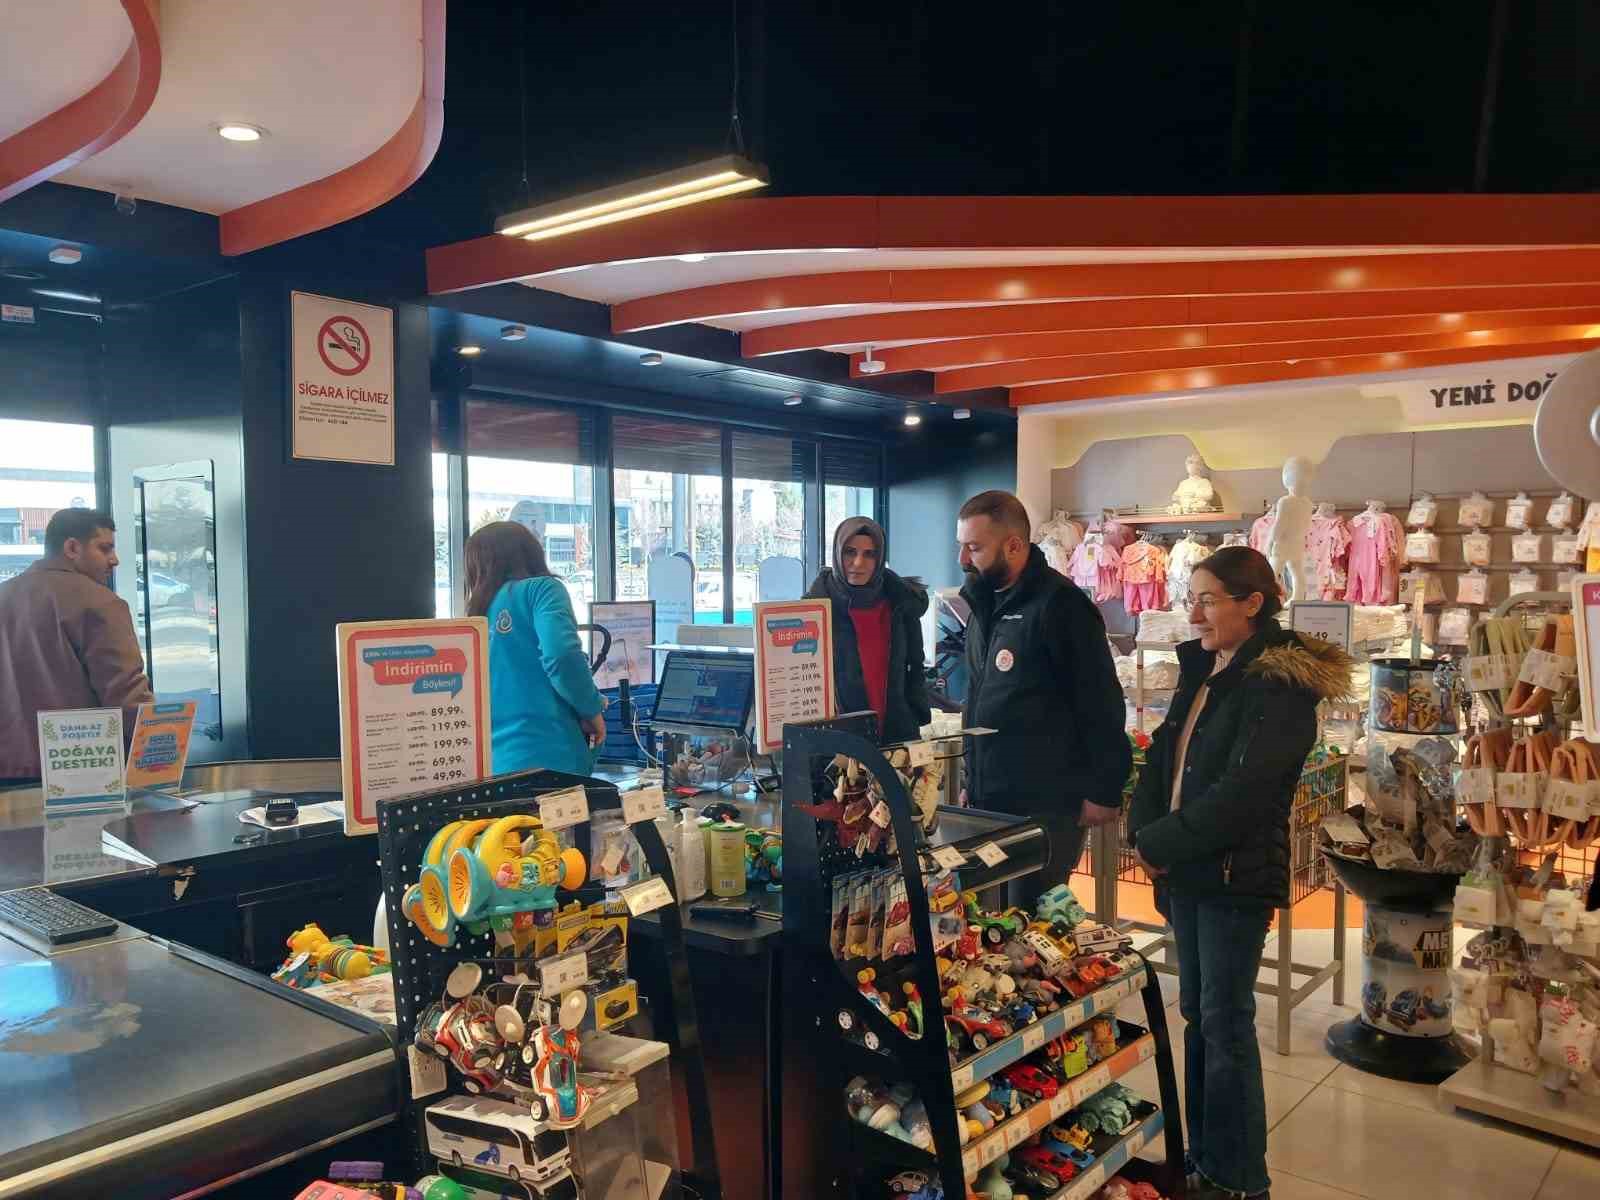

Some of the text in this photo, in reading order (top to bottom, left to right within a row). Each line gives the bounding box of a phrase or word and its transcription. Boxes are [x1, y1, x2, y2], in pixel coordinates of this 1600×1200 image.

[298, 379, 389, 405] SİGARA İÇİLMEZ
[1430, 378, 1496, 408] YENİ
[385, 660, 453, 677] İndirimin
[49, 744, 116, 759] DOĞAYA
[52, 759, 114, 770] DESTEK!
